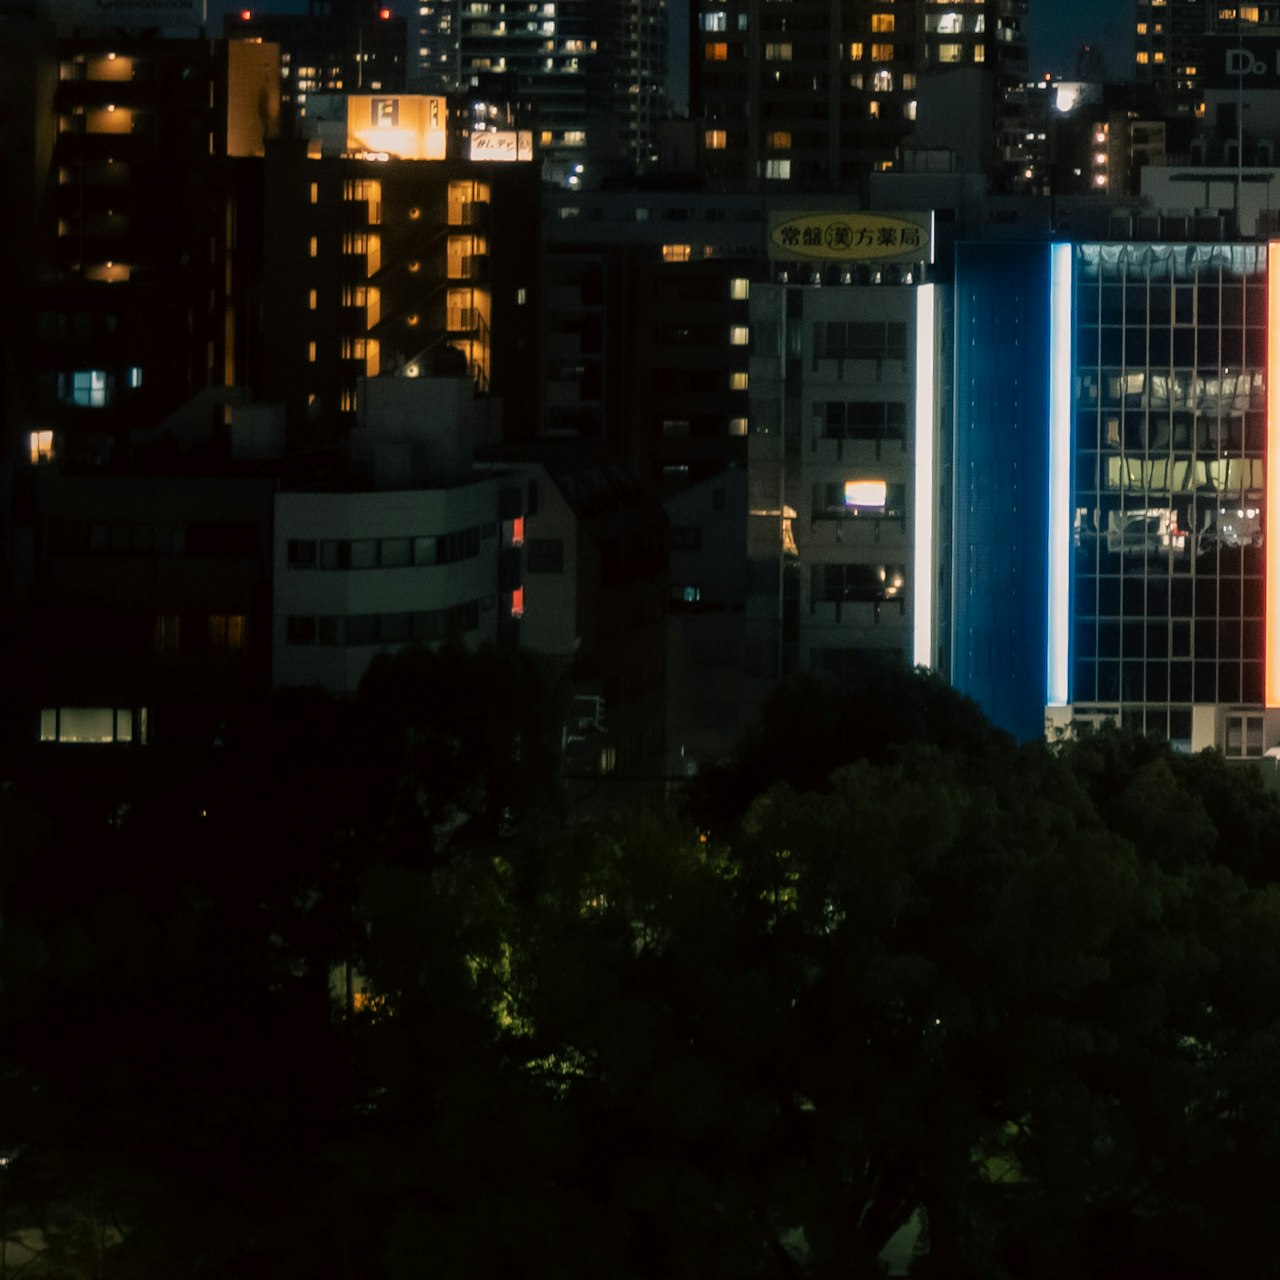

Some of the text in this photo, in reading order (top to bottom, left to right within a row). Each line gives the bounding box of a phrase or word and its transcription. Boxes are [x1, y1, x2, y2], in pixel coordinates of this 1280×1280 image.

[1225, 49, 1267, 76] Do
[781, 224, 921, 251] 常盤漢方薬局
